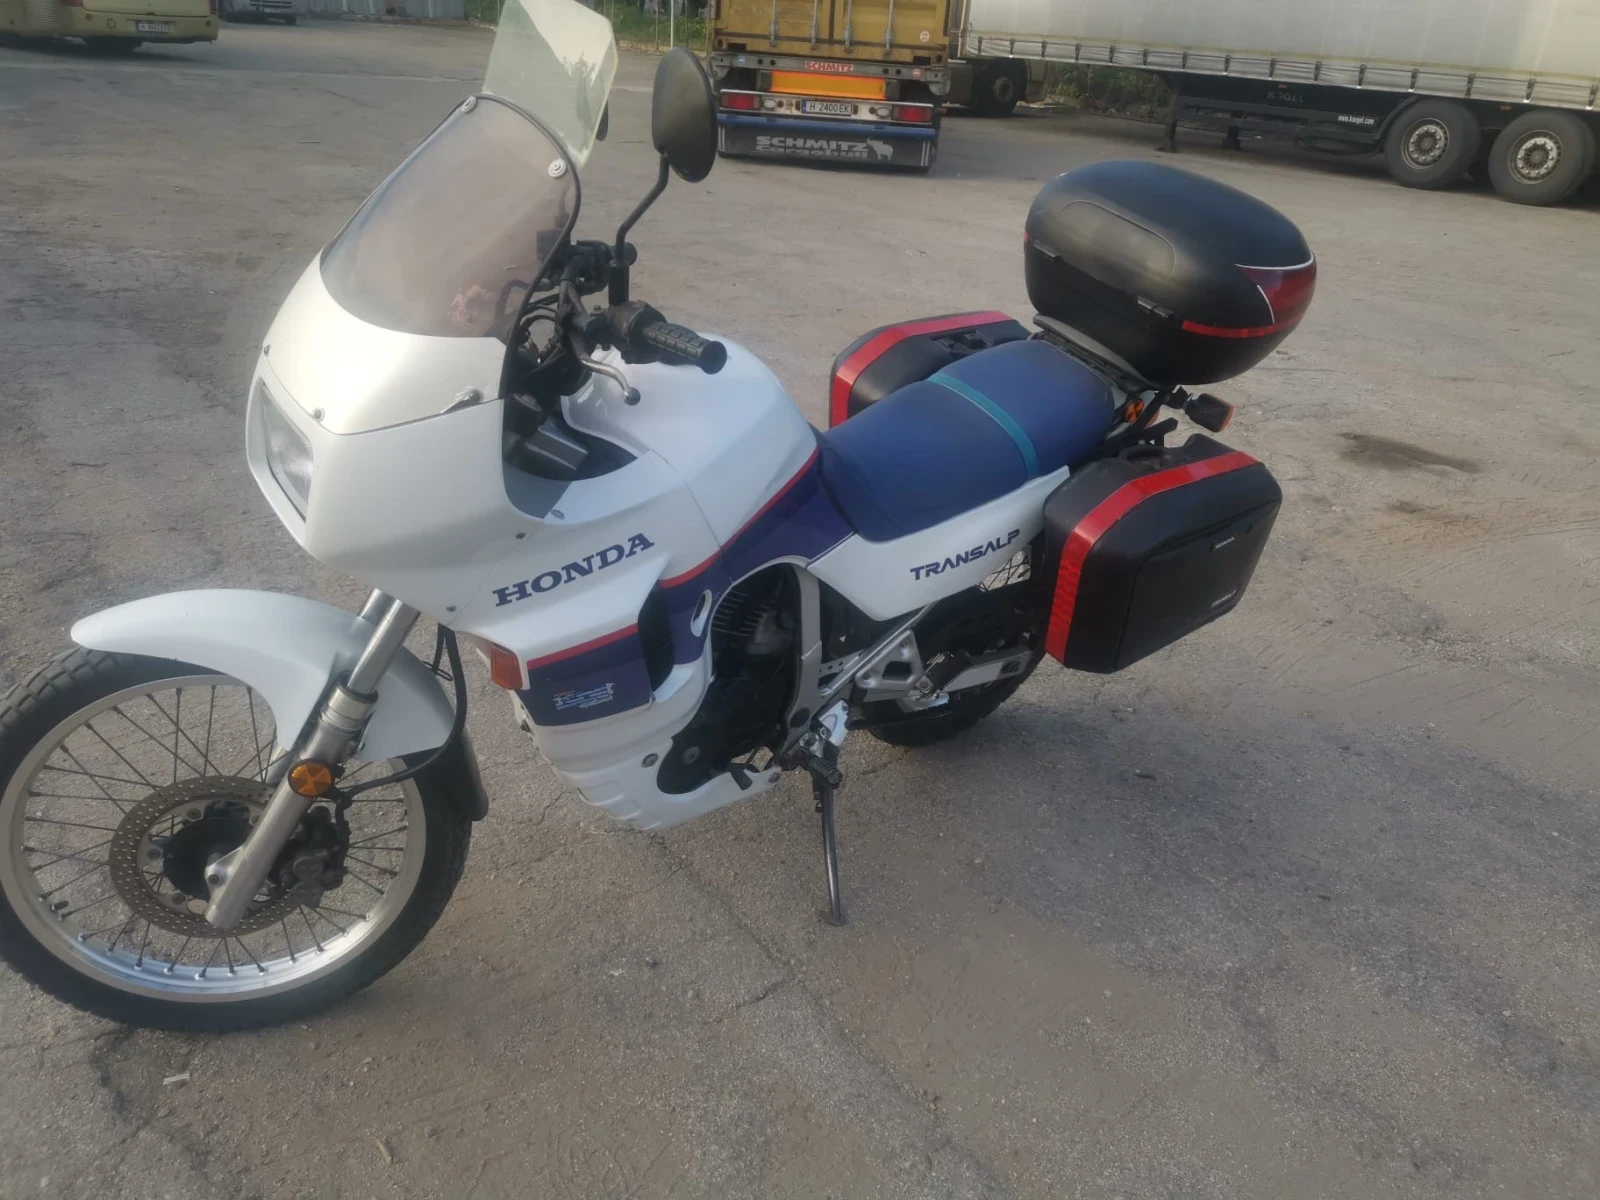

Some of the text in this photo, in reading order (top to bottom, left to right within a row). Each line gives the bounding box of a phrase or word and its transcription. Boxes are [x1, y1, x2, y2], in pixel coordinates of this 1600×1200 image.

[805, 61, 853, 72] SCHMITZ
[809, 101, 816, 111] H
[756, 136, 869, 153] SCHMITZ
[910, 529, 1020, 580] TRANSALP
[492, 533, 655, 607] HONDA
